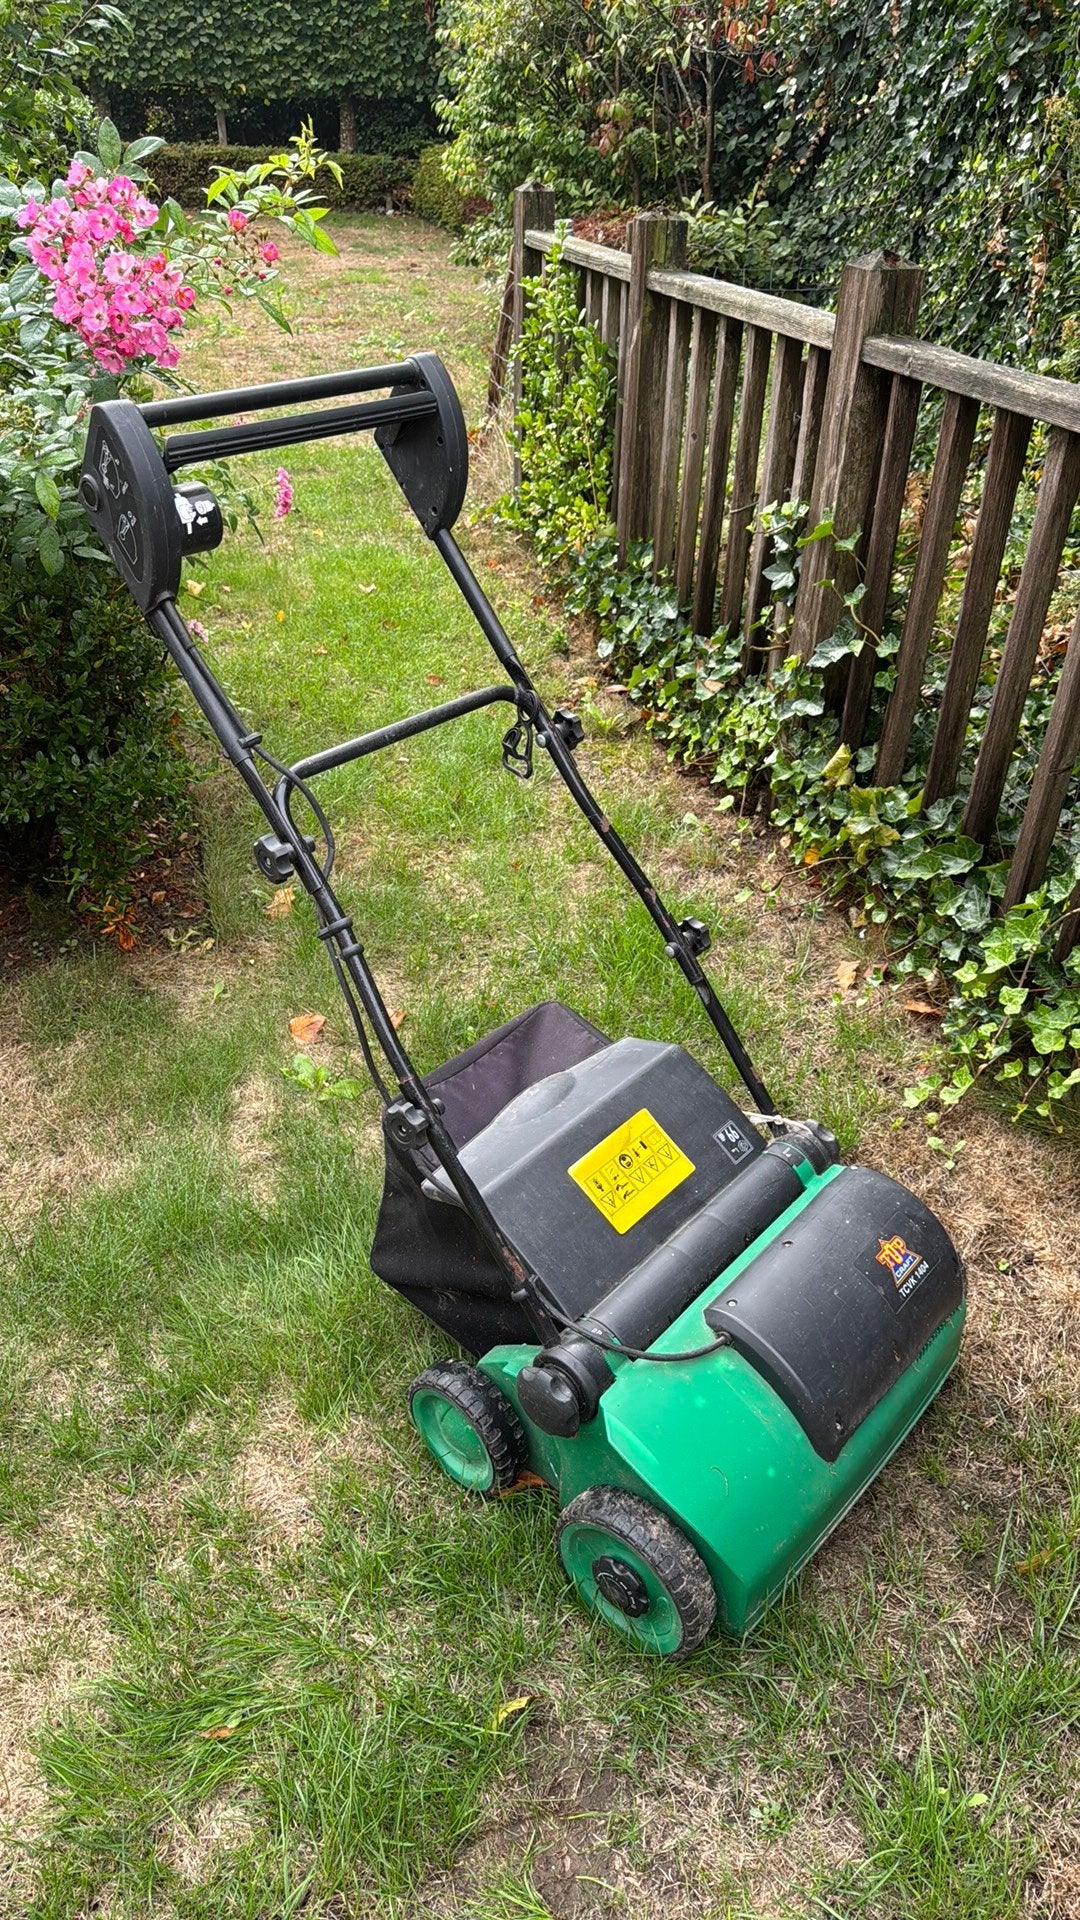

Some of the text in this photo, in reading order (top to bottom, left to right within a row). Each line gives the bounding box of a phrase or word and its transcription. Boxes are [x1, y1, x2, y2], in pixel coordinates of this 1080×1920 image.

[878, 1236, 907, 1268] TOP
[895, 1255, 914, 1278] CRAFT
[898, 1260, 930, 1297] TCVK 1404
